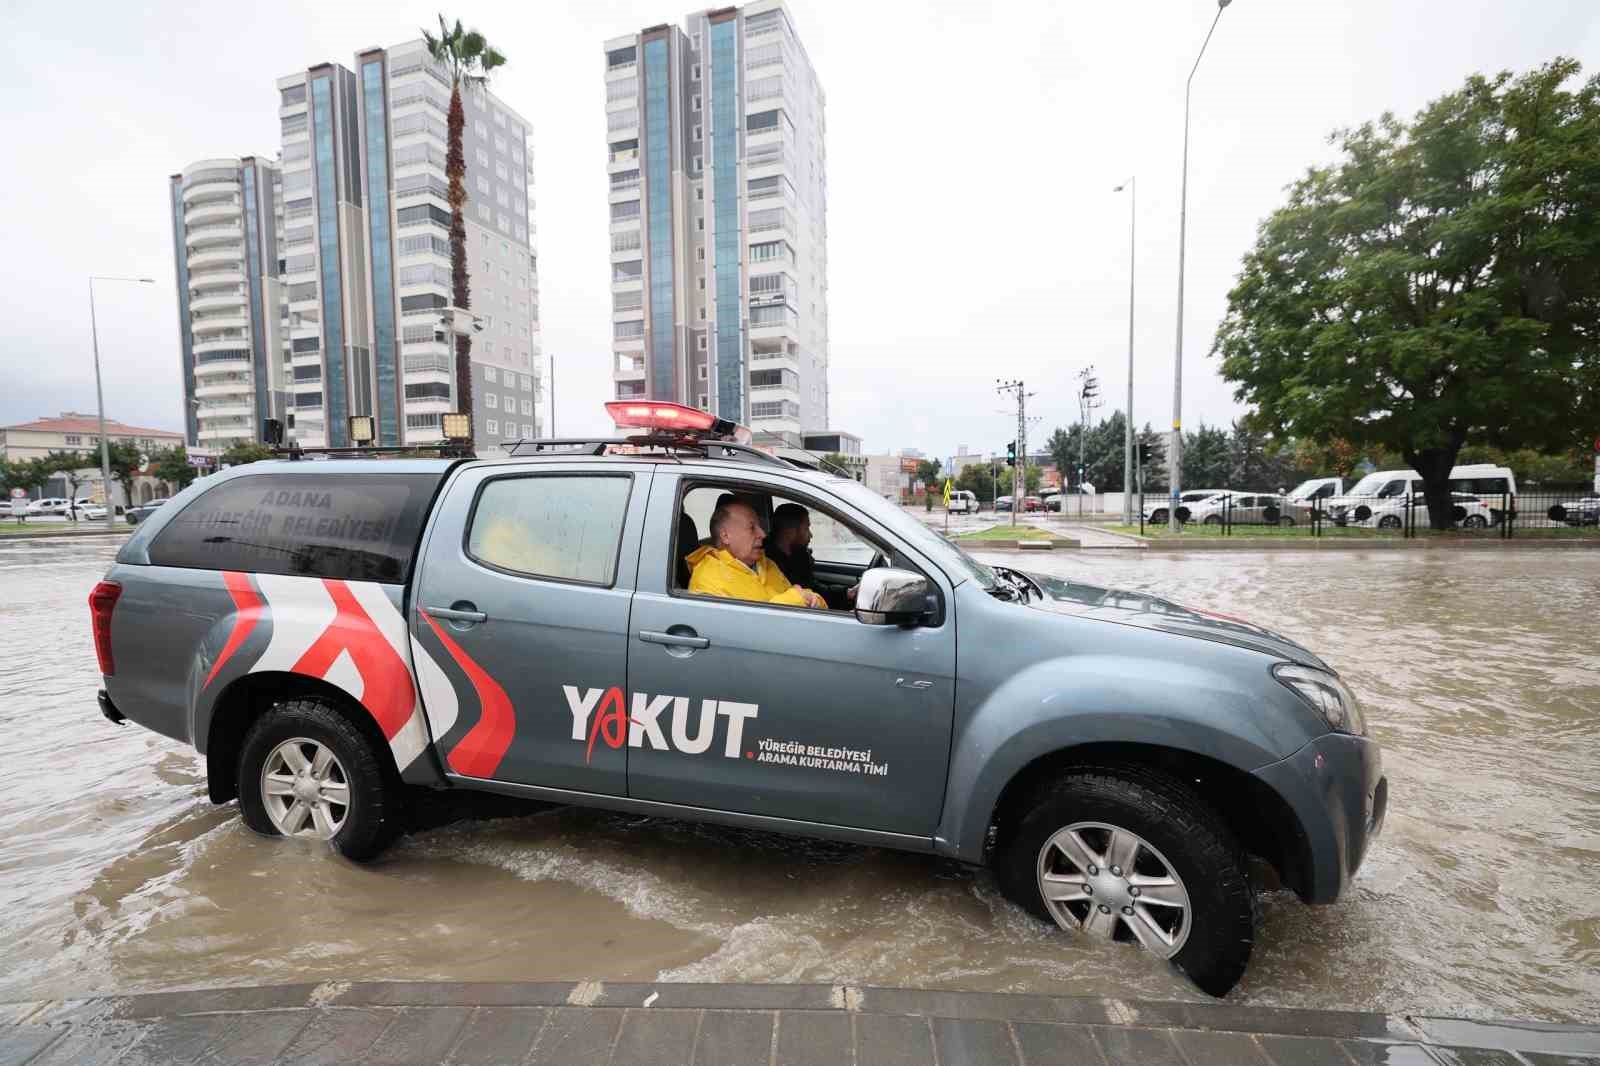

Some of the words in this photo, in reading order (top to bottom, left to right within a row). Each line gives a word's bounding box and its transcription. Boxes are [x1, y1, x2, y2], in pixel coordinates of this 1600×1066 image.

[259, 491, 332, 509] ADANA
[758, 738, 807, 756] YÜREĞİR
[807, 745, 871, 762] BELEDİYESİ
[757, 752, 798, 766] ARAMA
[799, 756, 860, 773] KURTARMA
[863, 762, 888, 776] TİMİ
